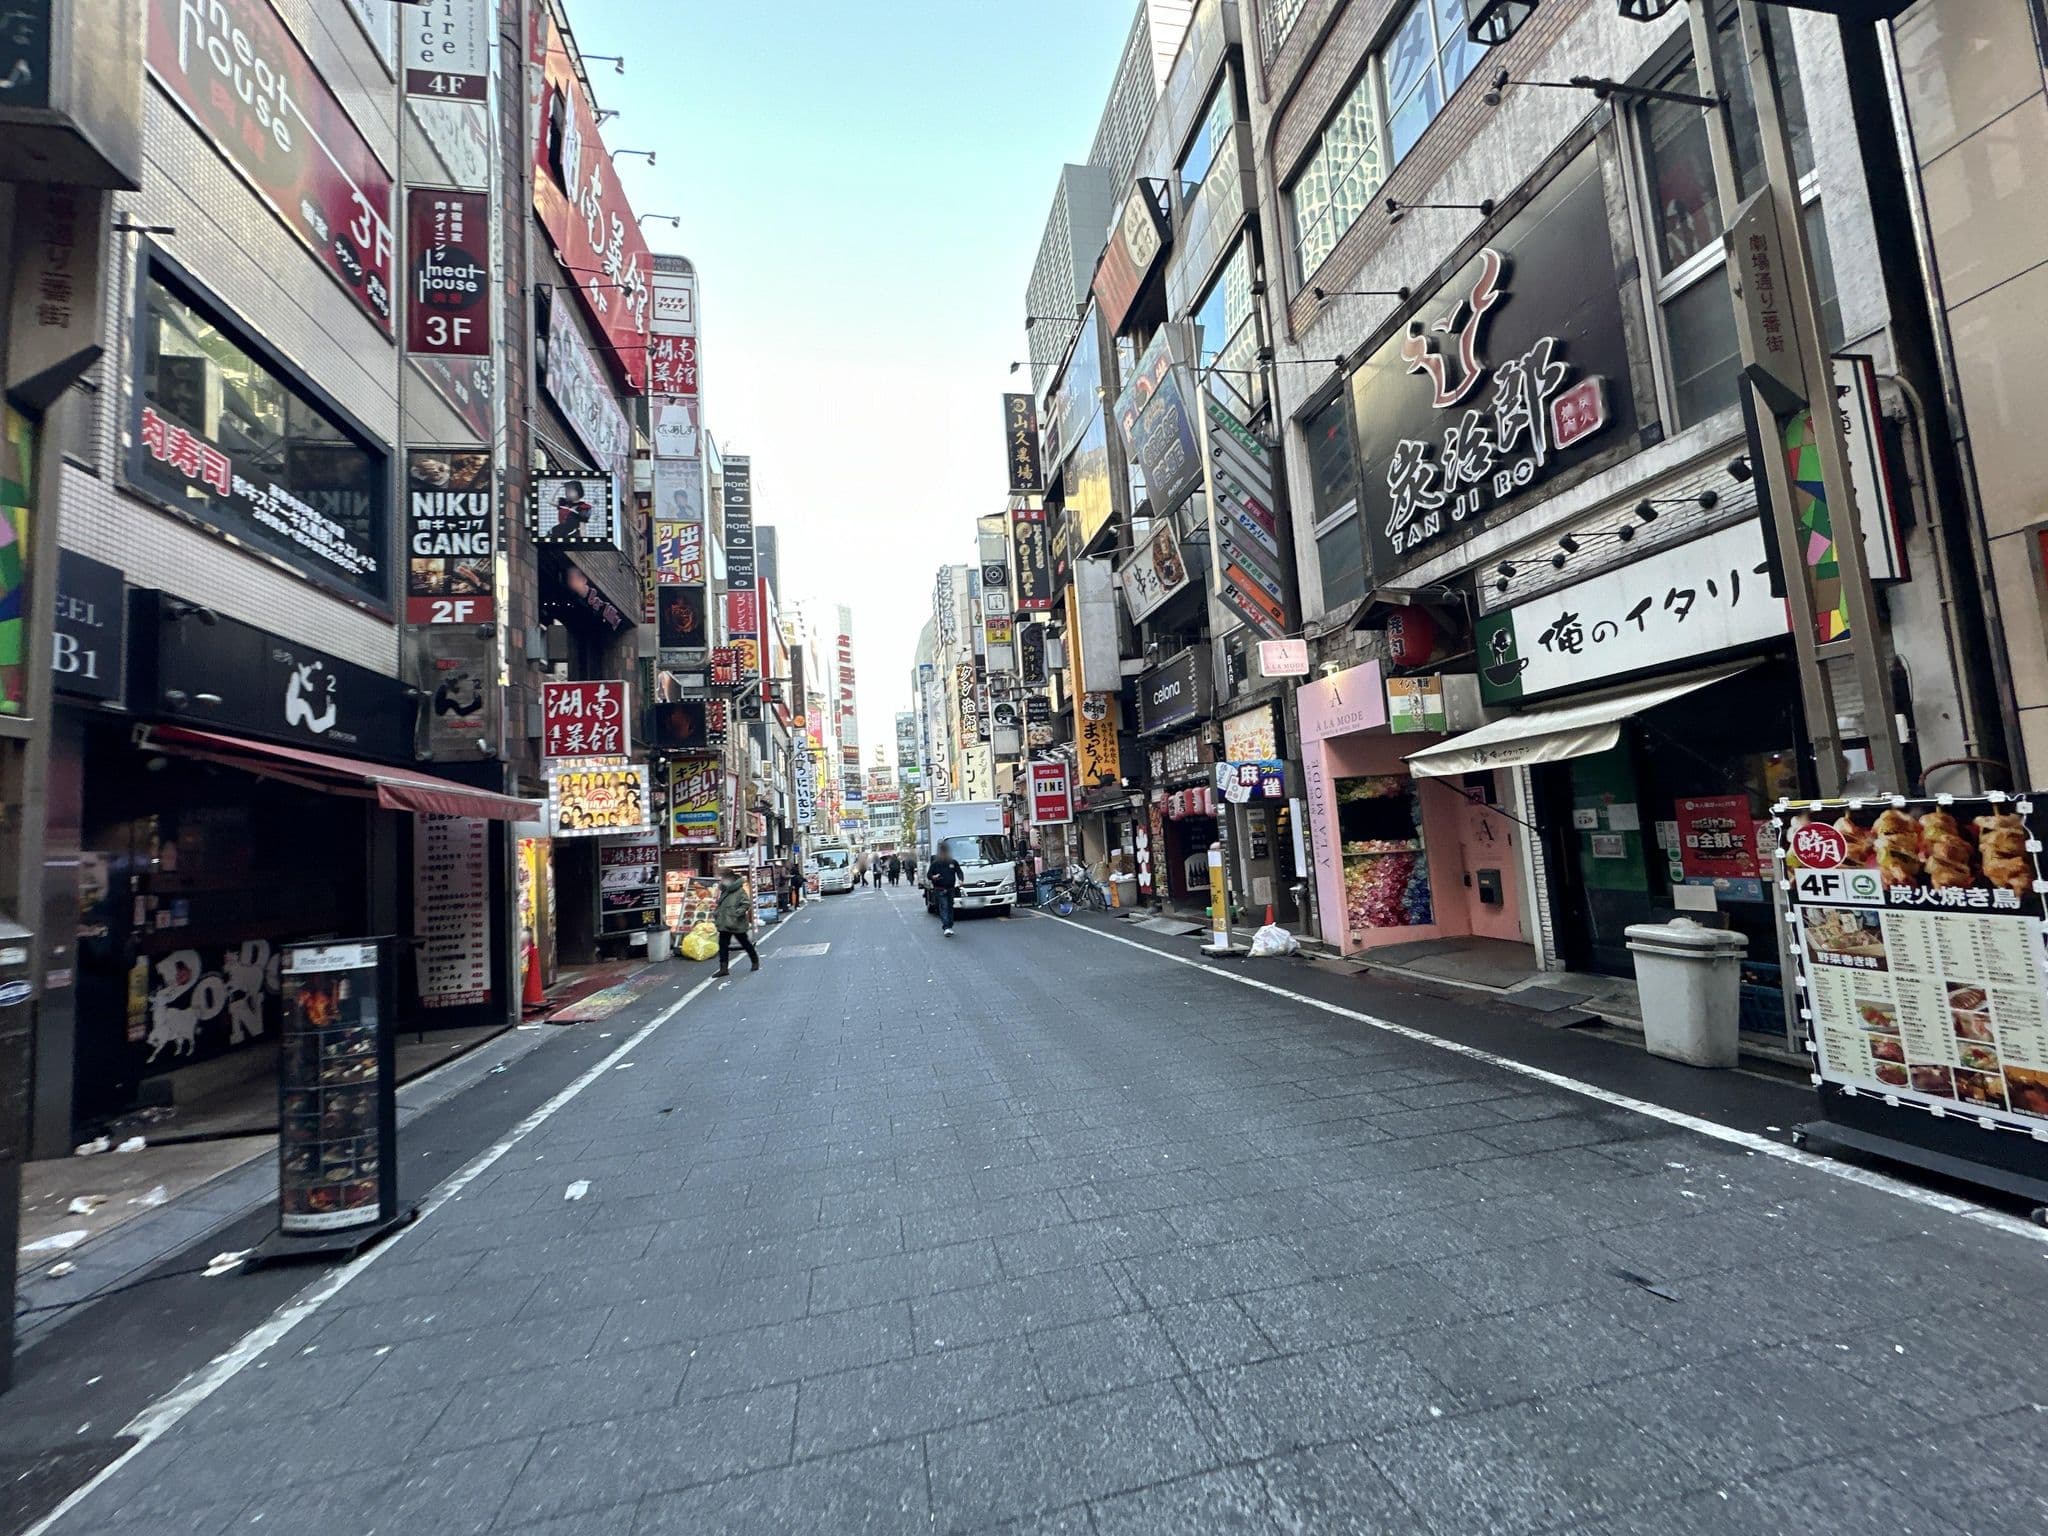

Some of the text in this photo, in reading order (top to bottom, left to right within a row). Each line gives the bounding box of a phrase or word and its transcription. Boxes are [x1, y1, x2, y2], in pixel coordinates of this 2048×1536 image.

[428, 74, 466, 95] 4F
[350, 192, 395, 268] 3F
[426, 249, 486, 279] meat
[419, 270, 479, 304] house
[1749, 233, 1785, 354] 劇場通り一番街
[426, 316, 472, 346] 3F
[652, 338, 695, 362] 湖南
[142, 406, 232, 497] 肉寿司
[1213, 447, 1223, 457] 6
[411, 491, 489, 517] NIKU
[1217, 494, 1227, 503] 4
[1391, 458, 1535, 555] TAN JI RO
[417, 519, 485, 531] 肉ギャング
[1219, 516, 1230, 527] 3
[412, 532, 490, 555] GANG
[660, 524, 674, 565] カフェ
[680, 525, 700, 582] 出会い
[1221, 539, 1231, 549] 2
[1225, 584, 1239, 599] B1
[430, 600, 475, 624] 2F
[51, 631, 99, 680] B1
[547, 683, 620, 721] 湖南
[1153, 680, 1181, 705] celona
[1323, 718, 1336, 730] LA
[1337, 710, 1364, 726] MODE
[548, 724, 562, 754] 4F
[563, 722, 620, 753] 菜館
[1084, 722, 1102, 777] まっちゃん
[675, 759, 710, 779] キラリ
[1240, 765, 1281, 796] 麻雀
[1261, 766, 1281, 774] フリー
[675, 770, 716, 804] 出会い
[692, 789, 717, 811] カフェ
[1698, 832, 1733, 849] 全額
[1797, 828, 1842, 863] 酔月
[1800, 873, 1840, 897] 4F
[1890, 885, 2022, 910] 炭火焼き鳥
